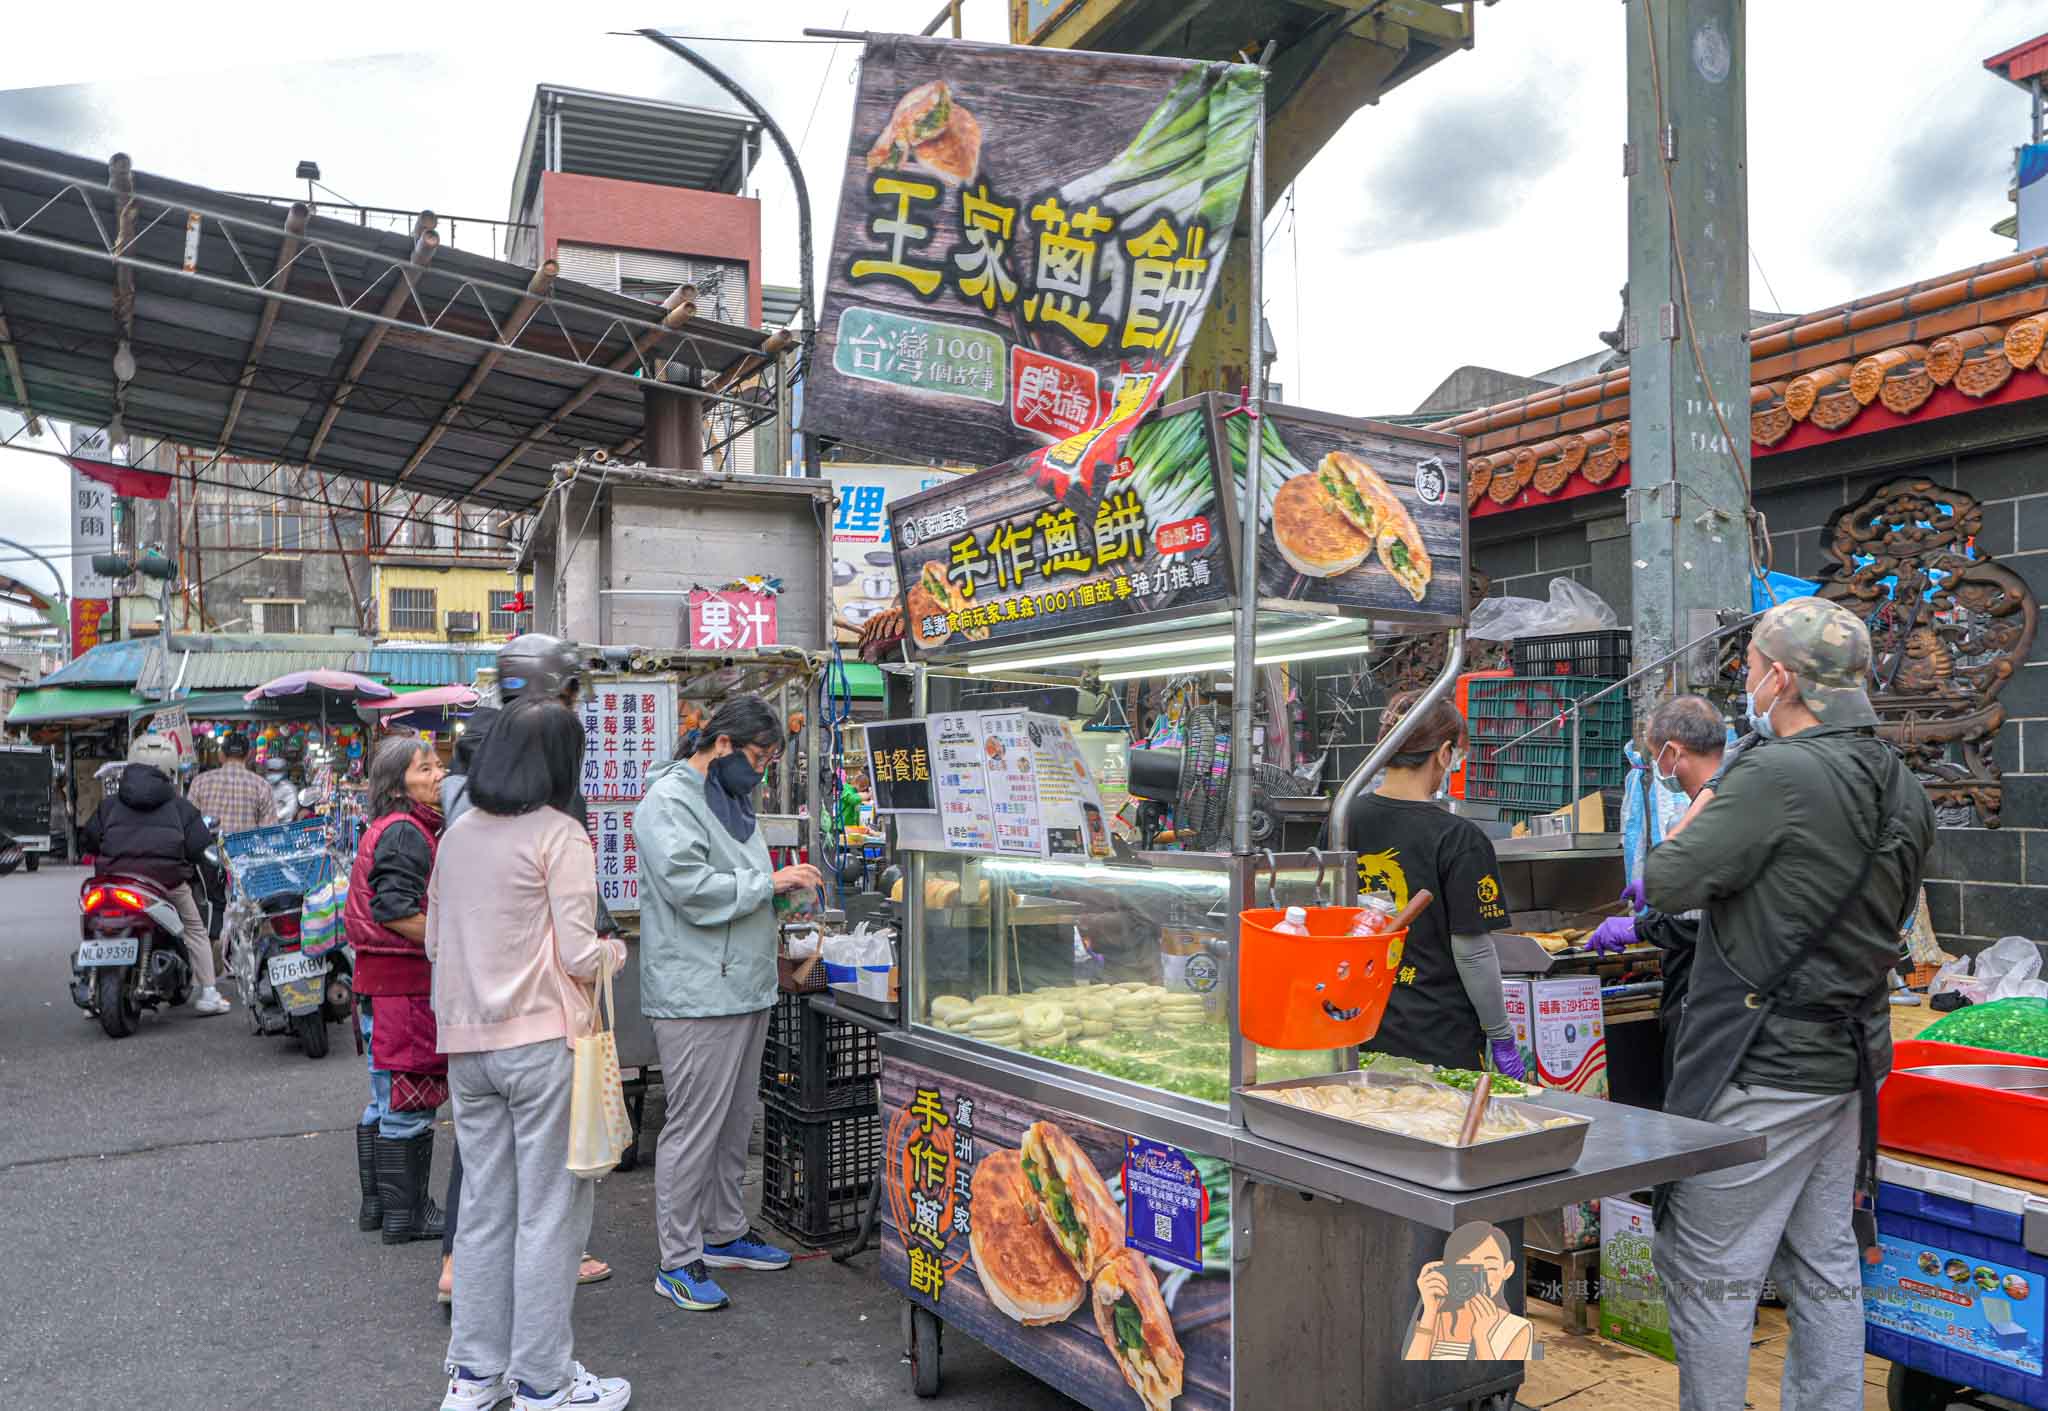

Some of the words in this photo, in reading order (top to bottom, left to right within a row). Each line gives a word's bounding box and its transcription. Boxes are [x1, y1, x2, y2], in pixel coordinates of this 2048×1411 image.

[849, 324, 929, 383] 台灣
[929, 361, 994, 392] 個故事
[948, 491, 1146, 598] 手作蔥餅
[699, 601, 769, 649] 果汁
[603, 694, 618, 779] 草莓牛奶
[622, 694, 637, 779] 蘋果牛奶
[873, 747, 929, 783] 點餐處
[603, 783, 618, 800] 70
[603, 811, 618, 875] 石蓮花
[623, 811, 638, 875] 奇異果
[604, 881, 618, 898] 65
[623, 880, 637, 898] 70
[909, 1089, 949, 1303] 手作蔥餅
